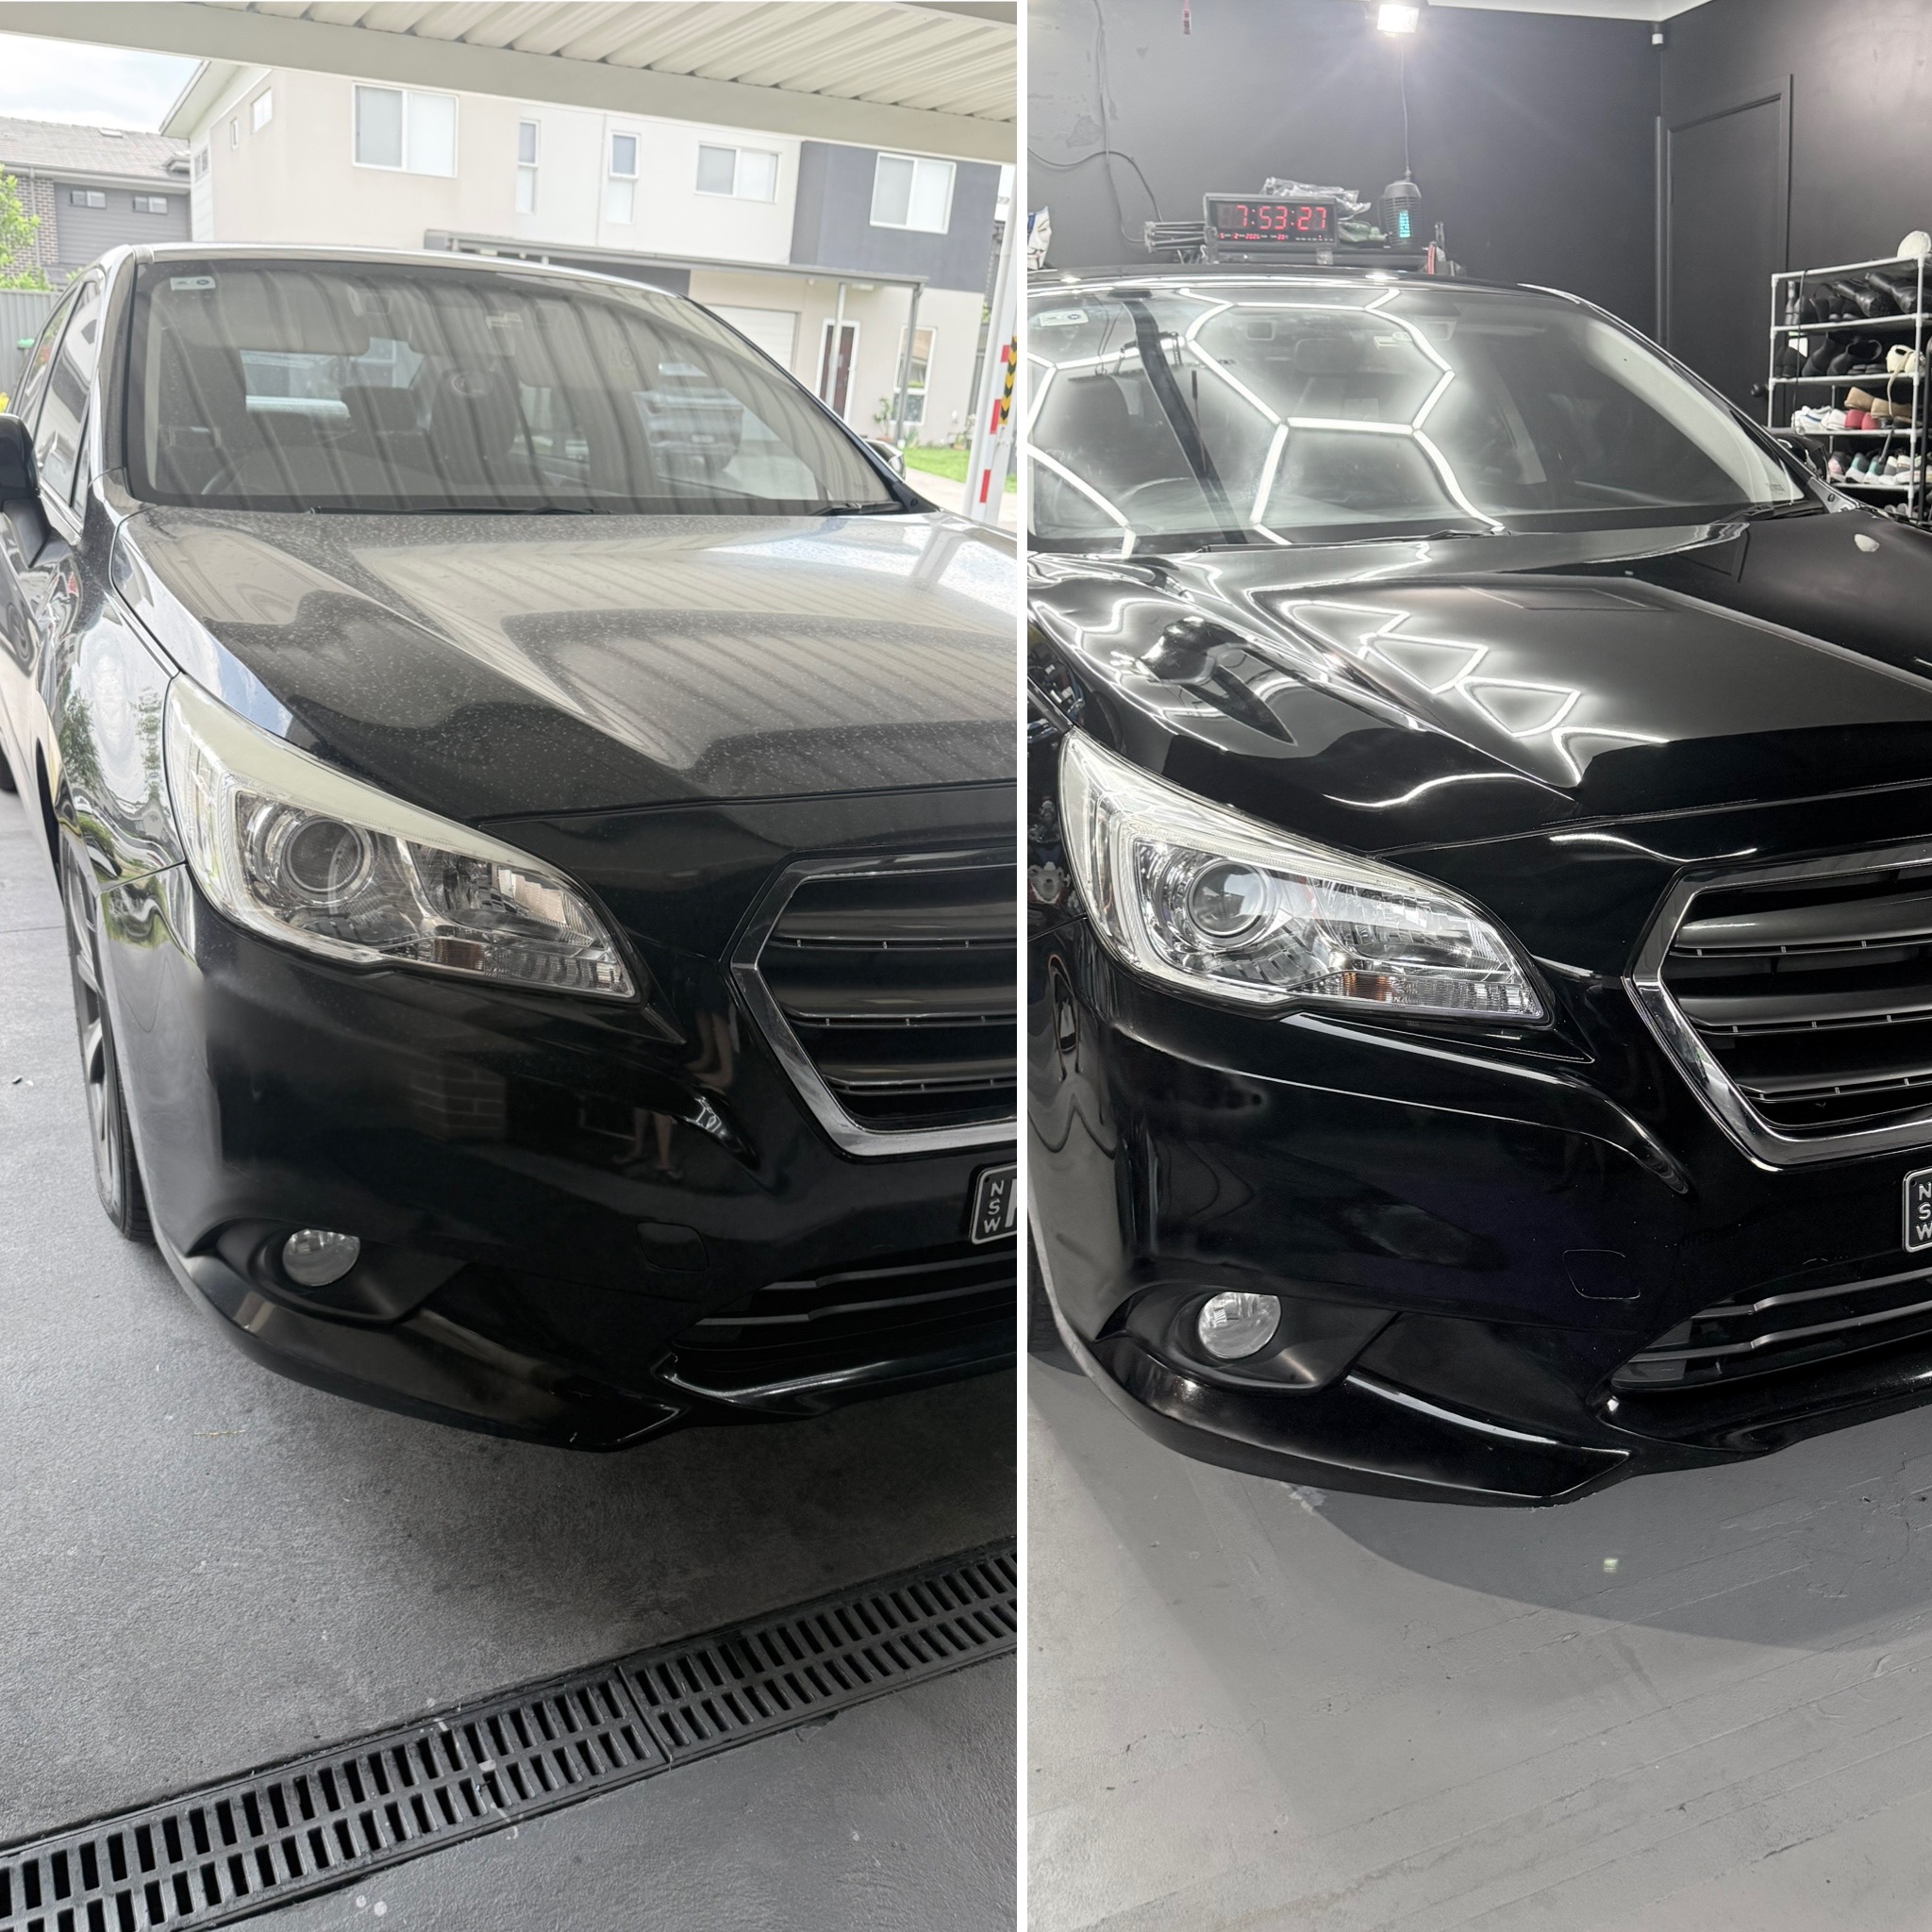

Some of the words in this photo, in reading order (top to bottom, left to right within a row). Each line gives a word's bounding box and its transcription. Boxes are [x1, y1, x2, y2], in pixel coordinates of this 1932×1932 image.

[1237, 205, 1326, 230] 7:53:27
[983, 1179, 1005, 1234] NSW
[1915, 1181, 1932, 1241] NSW
